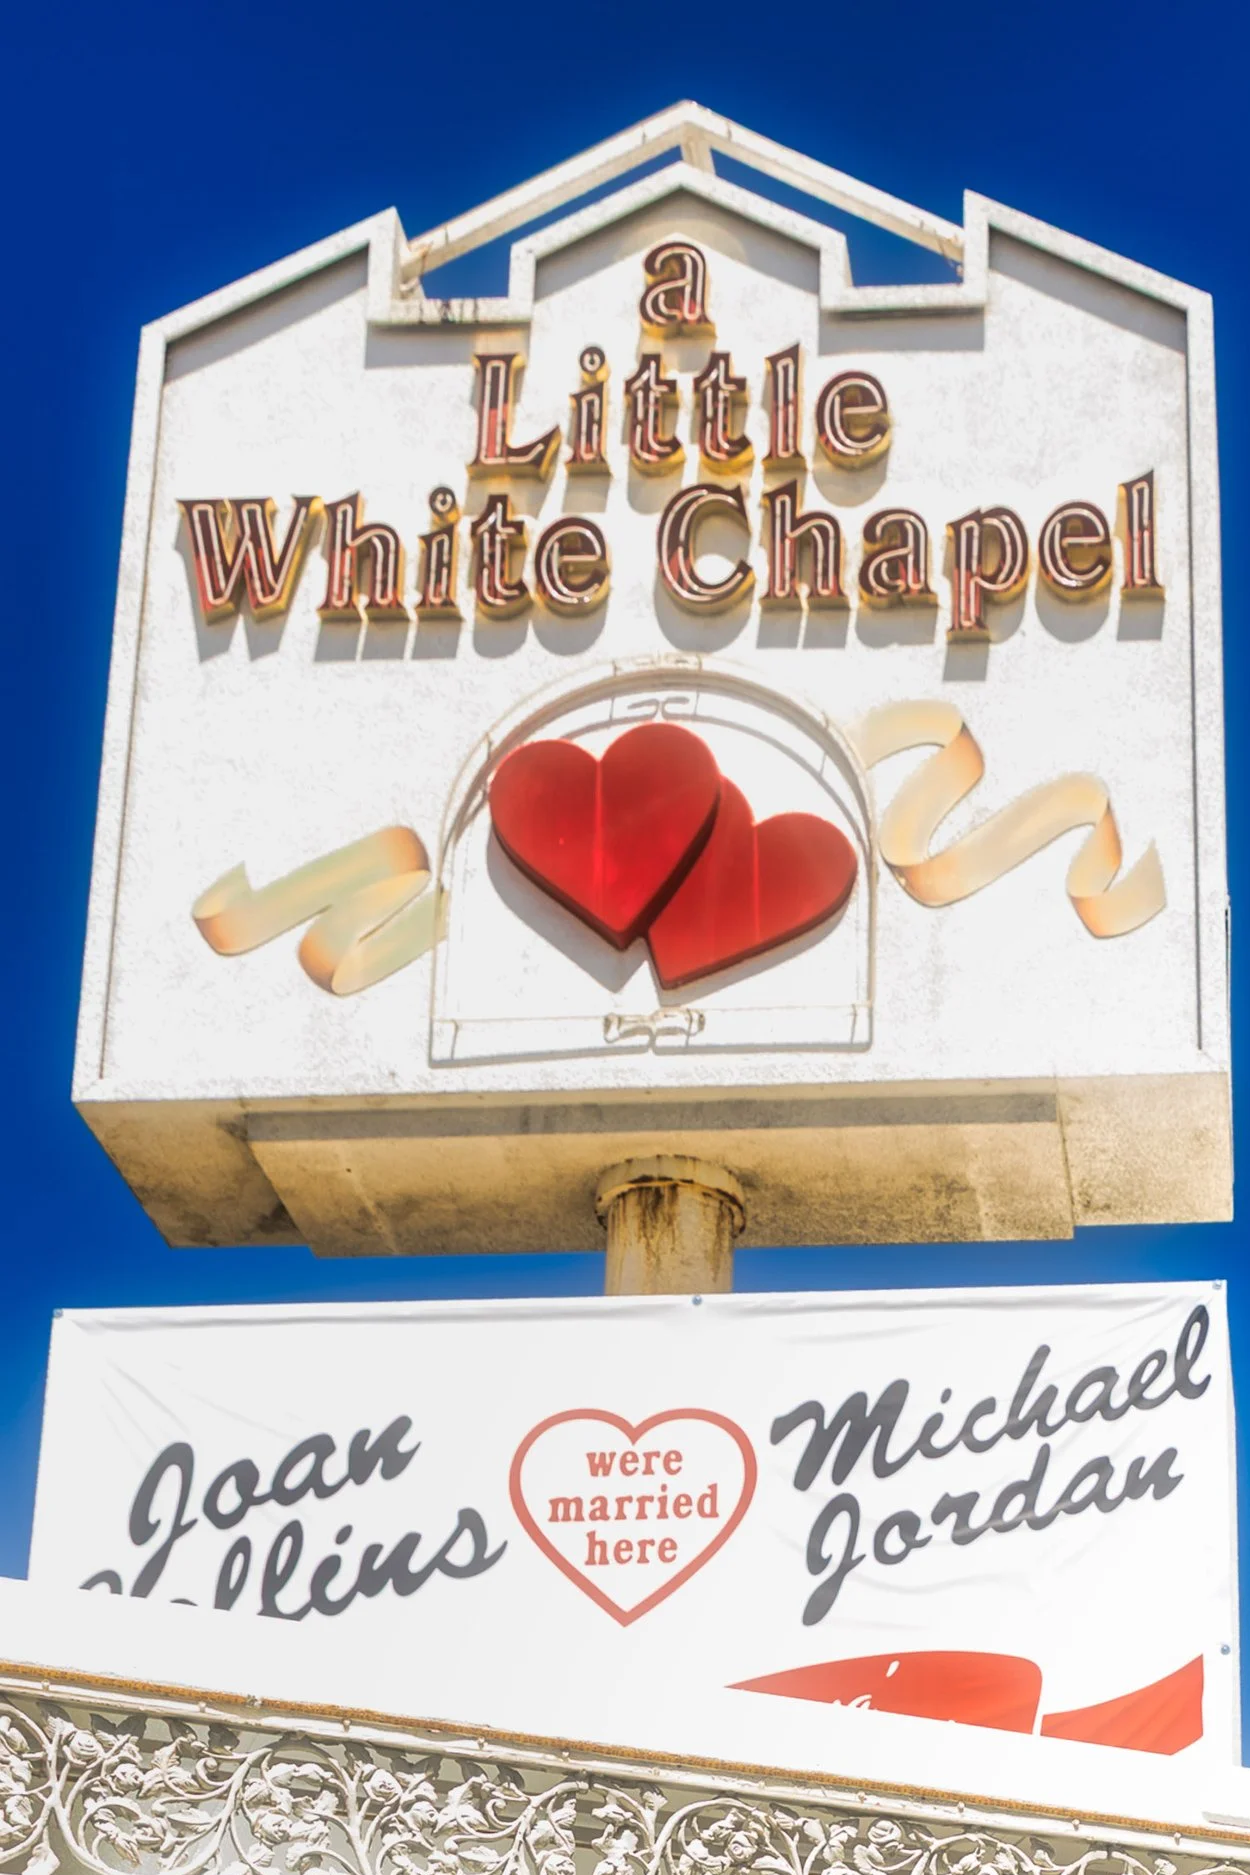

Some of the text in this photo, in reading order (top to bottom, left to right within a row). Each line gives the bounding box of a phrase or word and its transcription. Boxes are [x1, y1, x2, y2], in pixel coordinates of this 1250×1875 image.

[640, 241, 715, 336] a
[468, 344, 892, 478] Little
[176, 468, 1164, 640] White Chapel
[769, 1304, 1211, 1490] Michael
[128, 1414, 421, 1597] Joan
[547, 1483, 719, 1522] married
[586, 1450, 683, 1477] were
[79, 1507, 508, 1622] llins
[584, 1530, 678, 1566] here
[801, 1443, 1184, 1626] Jordan
